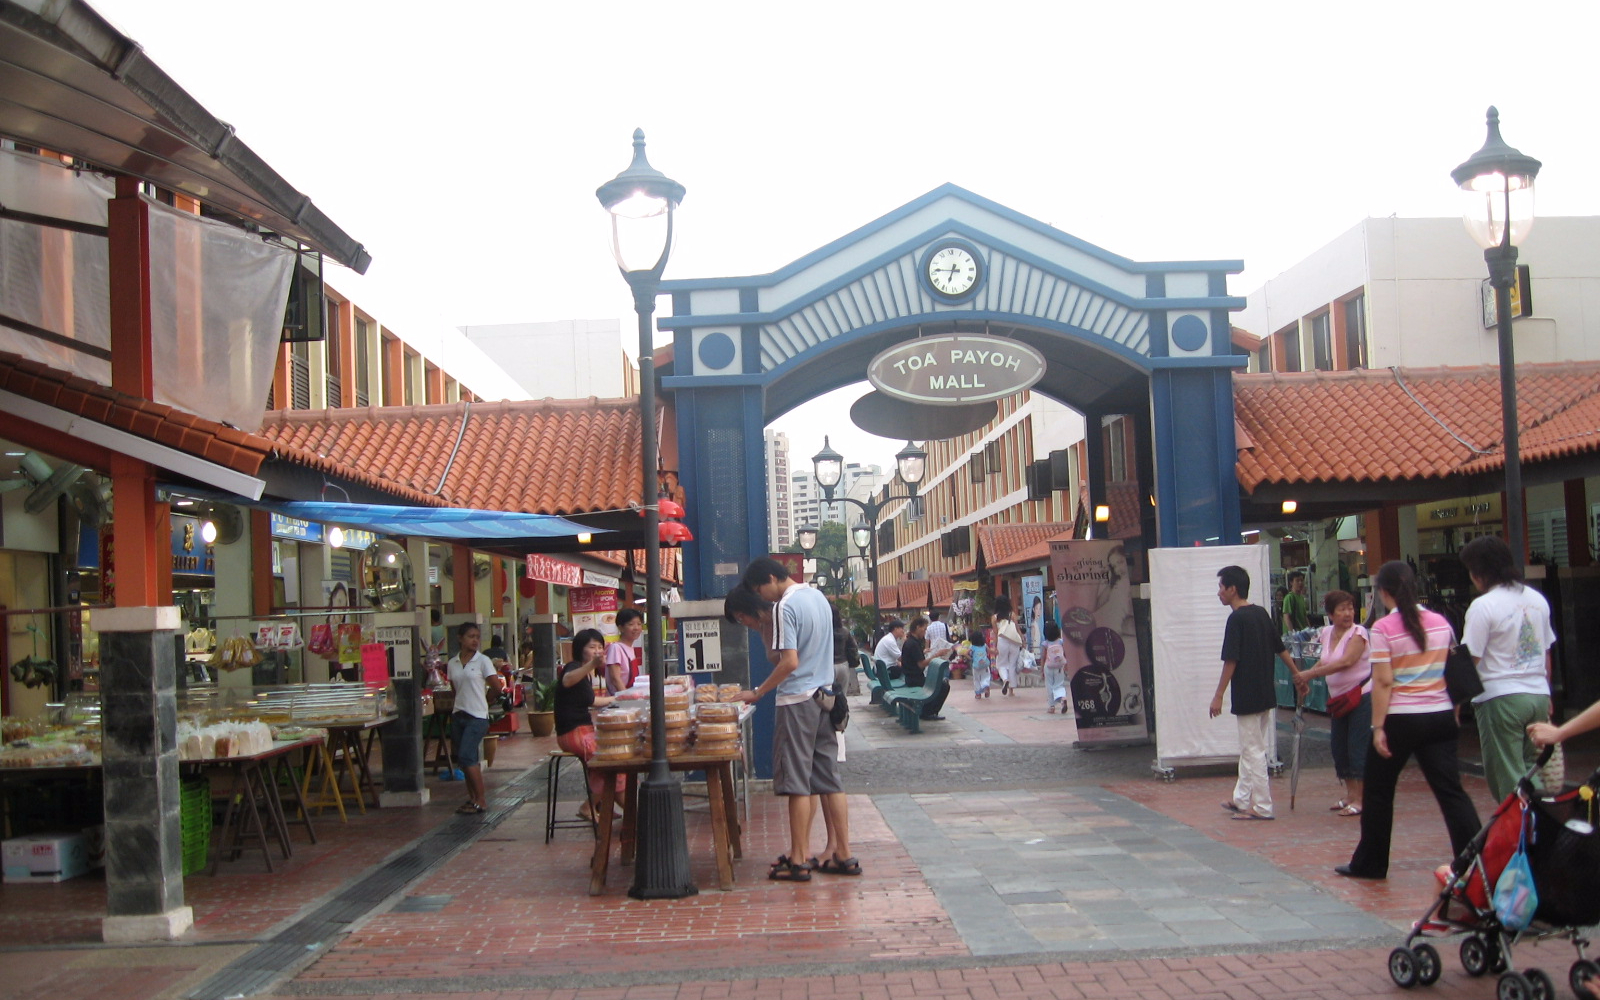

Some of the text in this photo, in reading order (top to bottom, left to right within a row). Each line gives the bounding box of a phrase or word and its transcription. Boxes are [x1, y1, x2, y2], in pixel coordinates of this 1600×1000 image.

[893, 350, 1021, 375] TOA PAYOH
[929, 373, 986, 390] MALL
[1076, 557, 1103, 569] giving
[1056, 567, 1110, 584] sharing
[1077, 699, 1096, 710] $268
